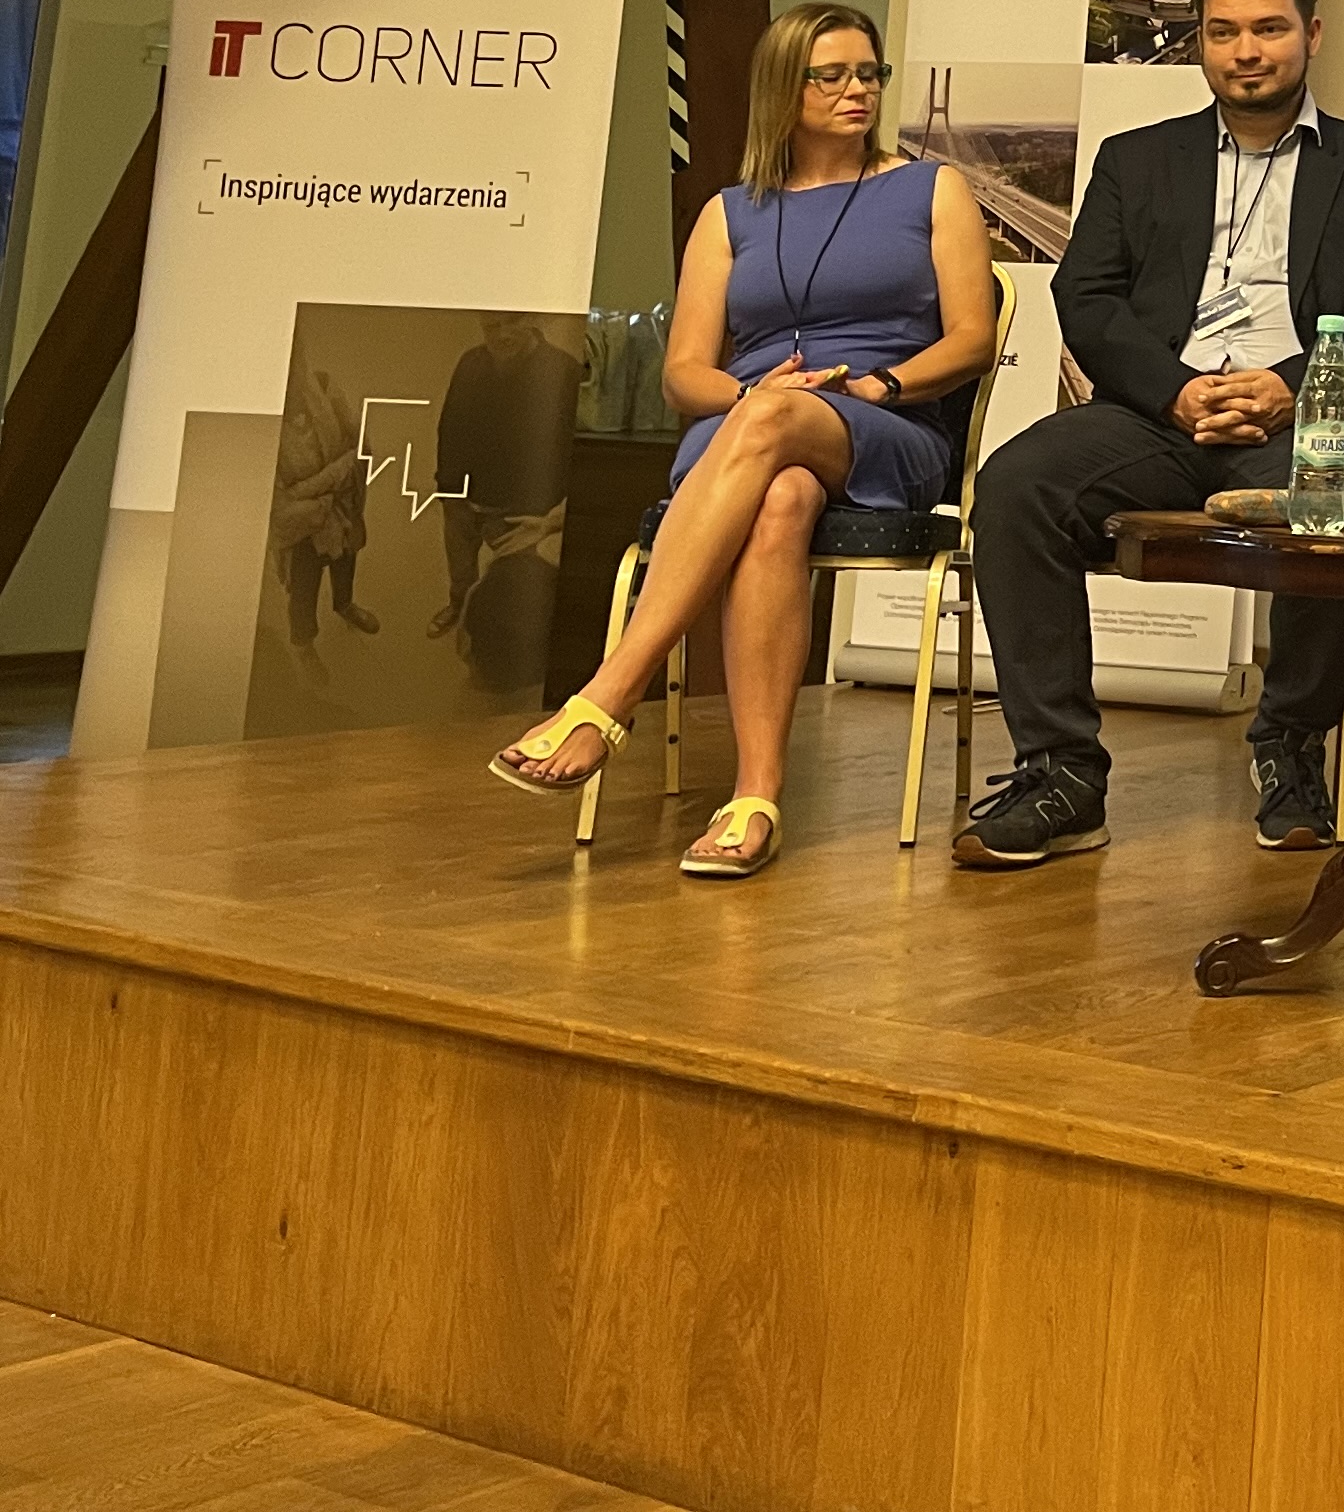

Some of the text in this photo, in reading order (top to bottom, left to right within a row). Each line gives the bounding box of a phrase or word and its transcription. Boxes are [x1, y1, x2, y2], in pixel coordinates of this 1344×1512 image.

[270, 23, 557, 89] CORNER
[220, 172, 507, 211] Inspirujące wydarzenia
